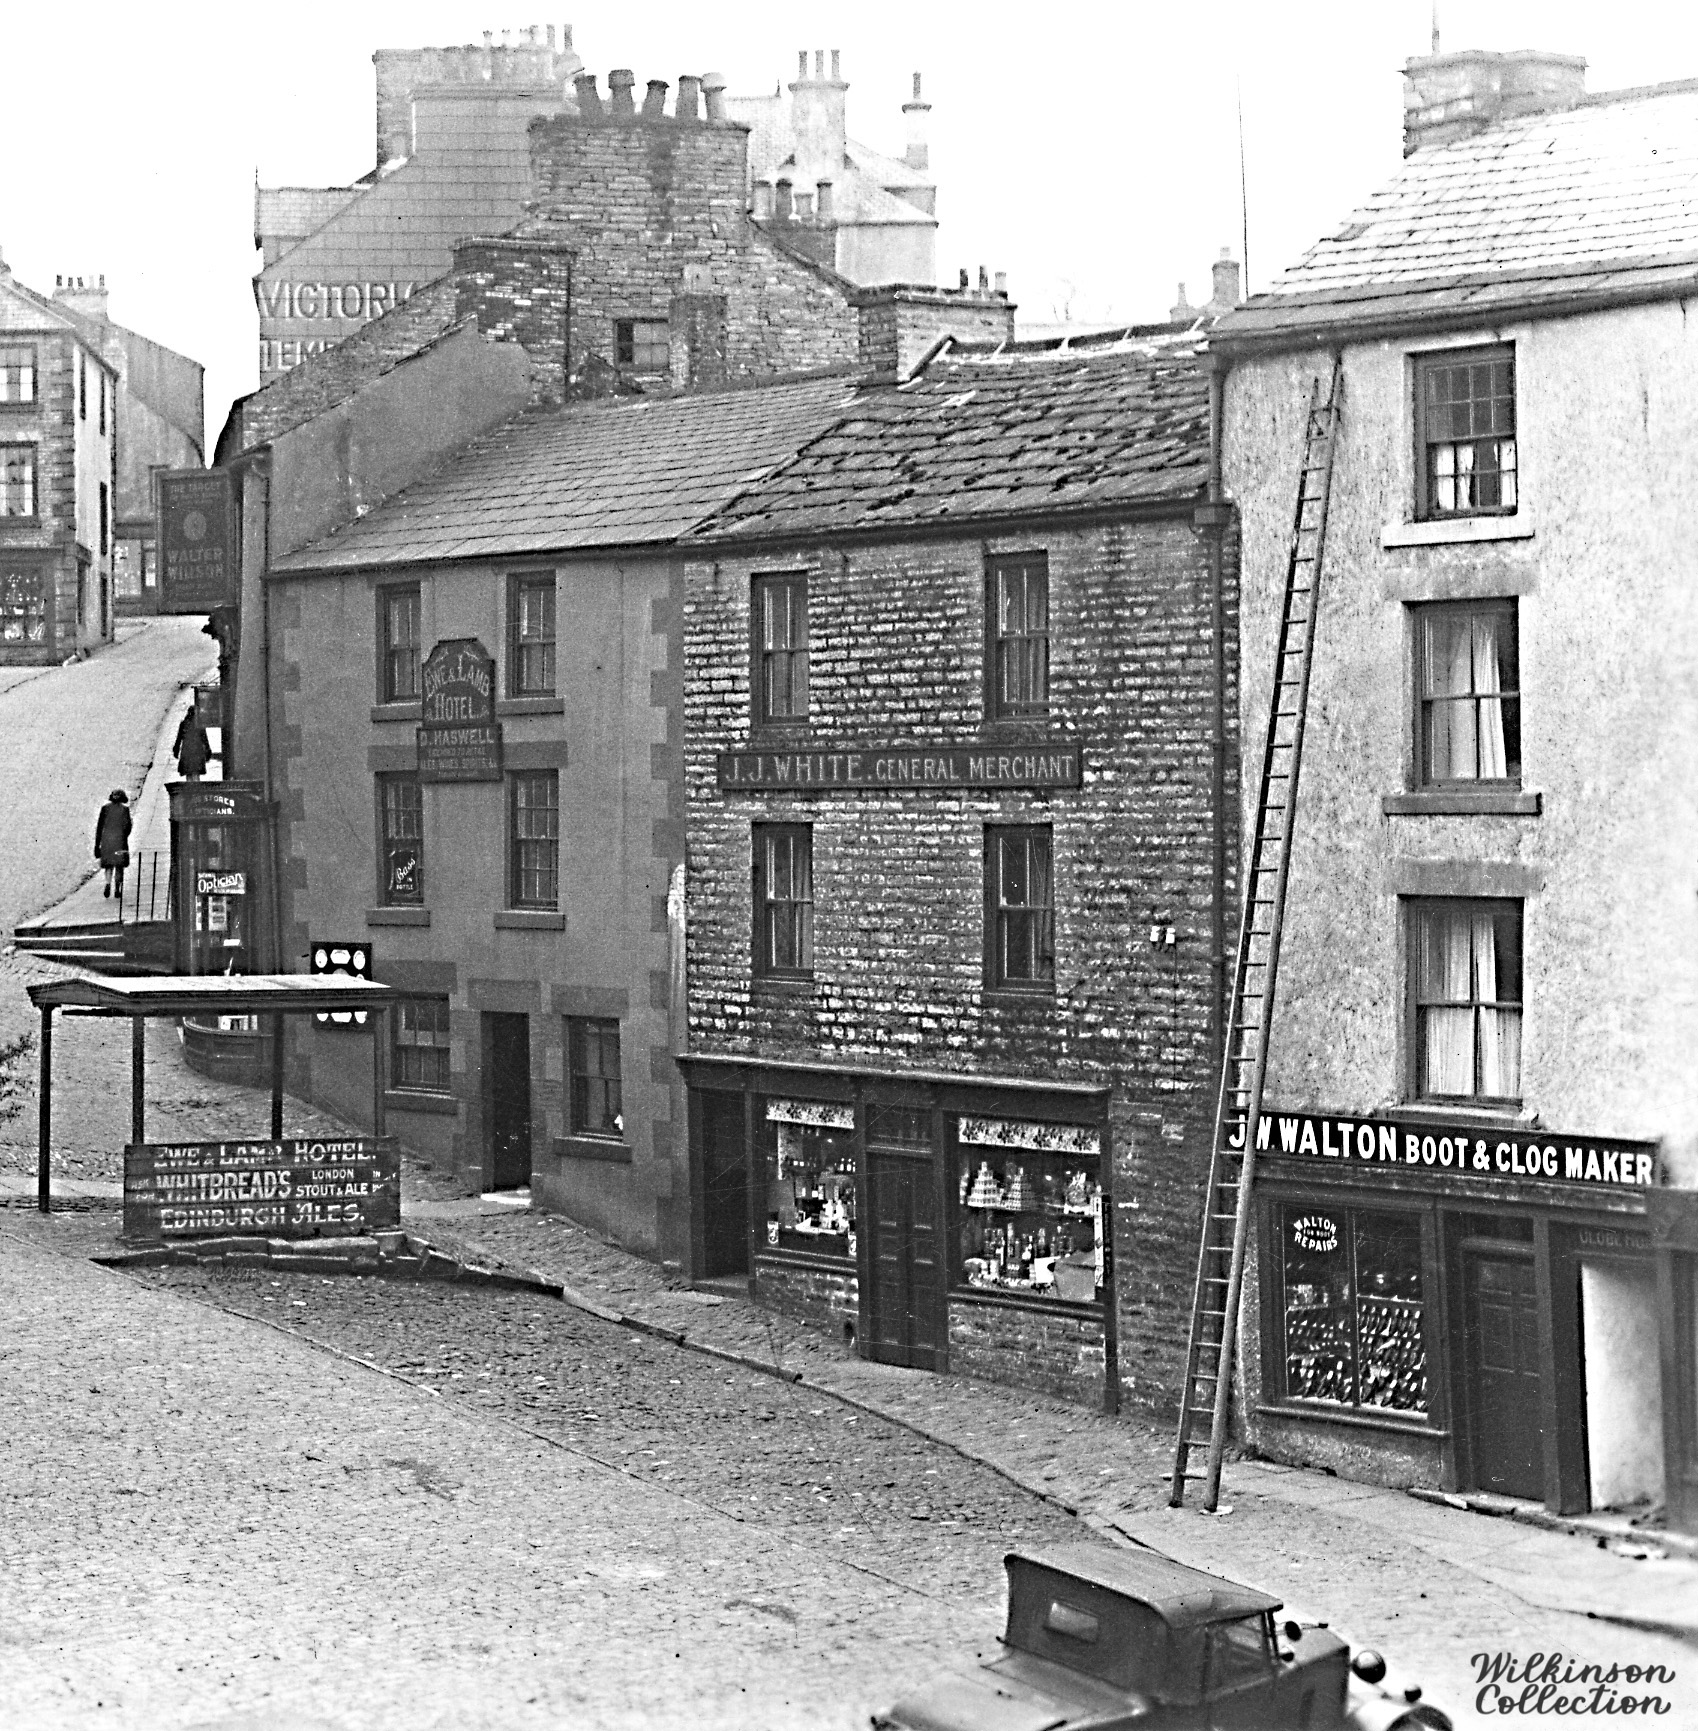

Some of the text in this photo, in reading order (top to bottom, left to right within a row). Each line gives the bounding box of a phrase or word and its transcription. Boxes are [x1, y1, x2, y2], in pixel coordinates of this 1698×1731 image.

[259, 339, 334, 371] TEM
[168, 548, 222, 562] WALTER
[424, 665, 448, 701] EWE
[457, 653, 490, 697] LAMB
[434, 692, 478, 721] HOTEL
[434, 727, 495, 745] HASWELL
[875, 757, 960, 781] GENERAL
[969, 755, 1074, 781] MERCHANT
[396, 857, 416, 885] Bass
[197, 873, 244, 894] Optician
[154, 1147, 200, 1168] EWE
[1405, 1134, 1469, 1168] BOOT
[1472, 1139, 1490, 1171] &
[1495, 1142, 1558, 1176] CLOG
[1565, 1147, 1652, 1185] MAKER
[311, 1168, 355, 1180] LONDON
[156, 1170, 291, 1202] WHITBREAD'S
[295, 1183, 335, 1198] STOUT
[336, 1187, 344, 1196] &
[344, 1182, 369, 1196] ALE
[160, 1206, 286, 1229] EDINBURGH
[1293, 1216, 1337, 1235] WALTON
[1294, 1231, 1338, 1252] REPAIRS
